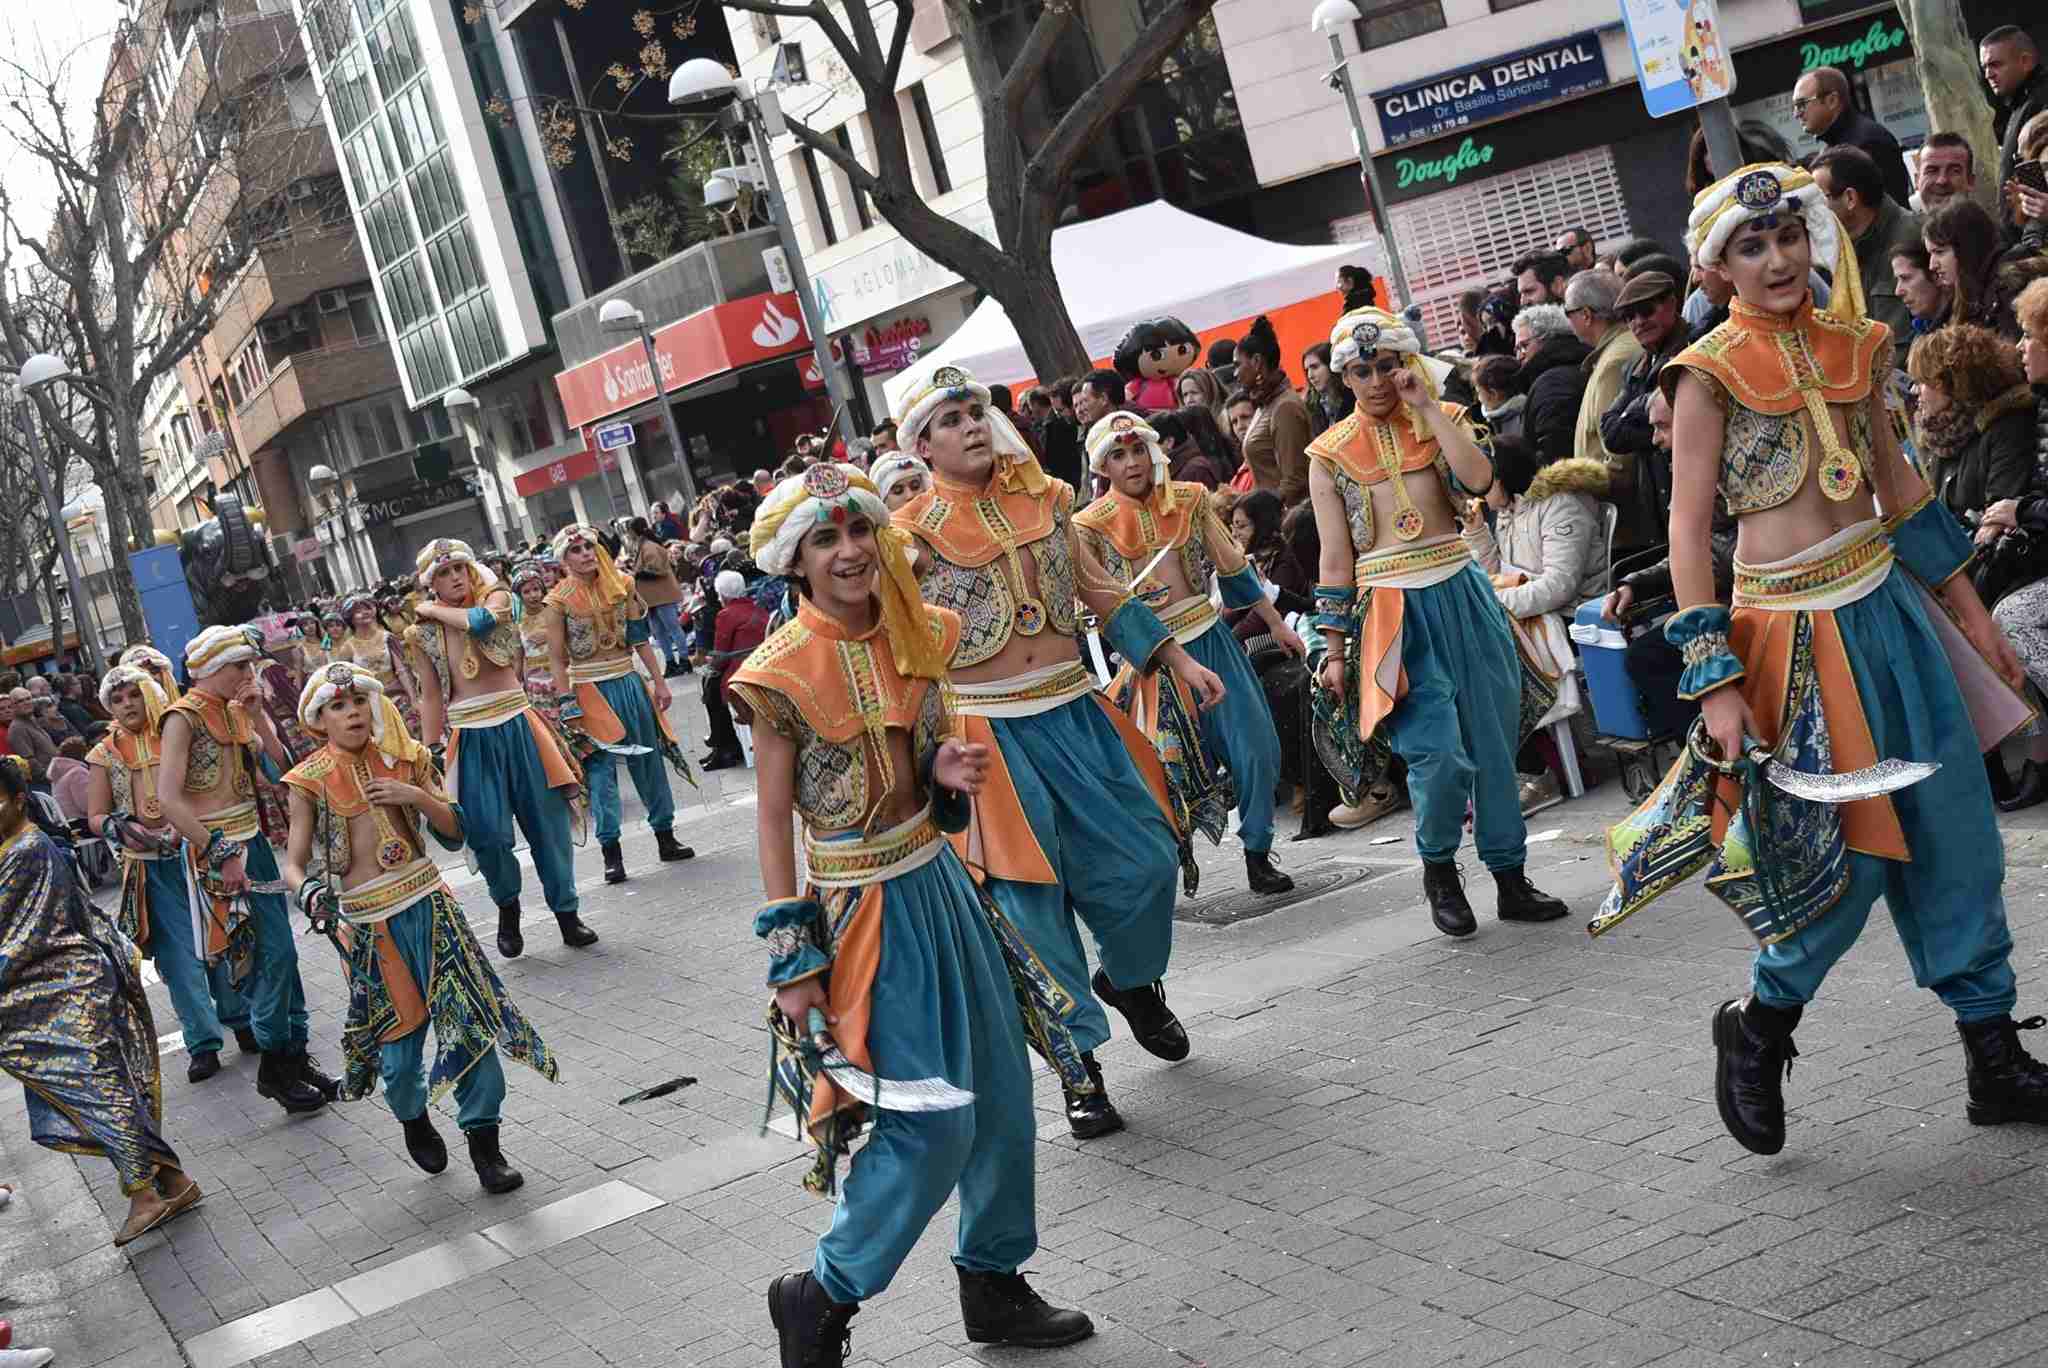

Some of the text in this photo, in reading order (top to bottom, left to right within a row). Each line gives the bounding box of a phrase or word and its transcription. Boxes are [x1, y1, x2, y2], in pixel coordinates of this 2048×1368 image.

[1801, 20, 1905, 74] Douglas
[1385, 45, 1593, 117] CLINICA DENTAL
[1455, 93, 1495, 113] Basilio
[1395, 137, 1494, 188] Douglas
